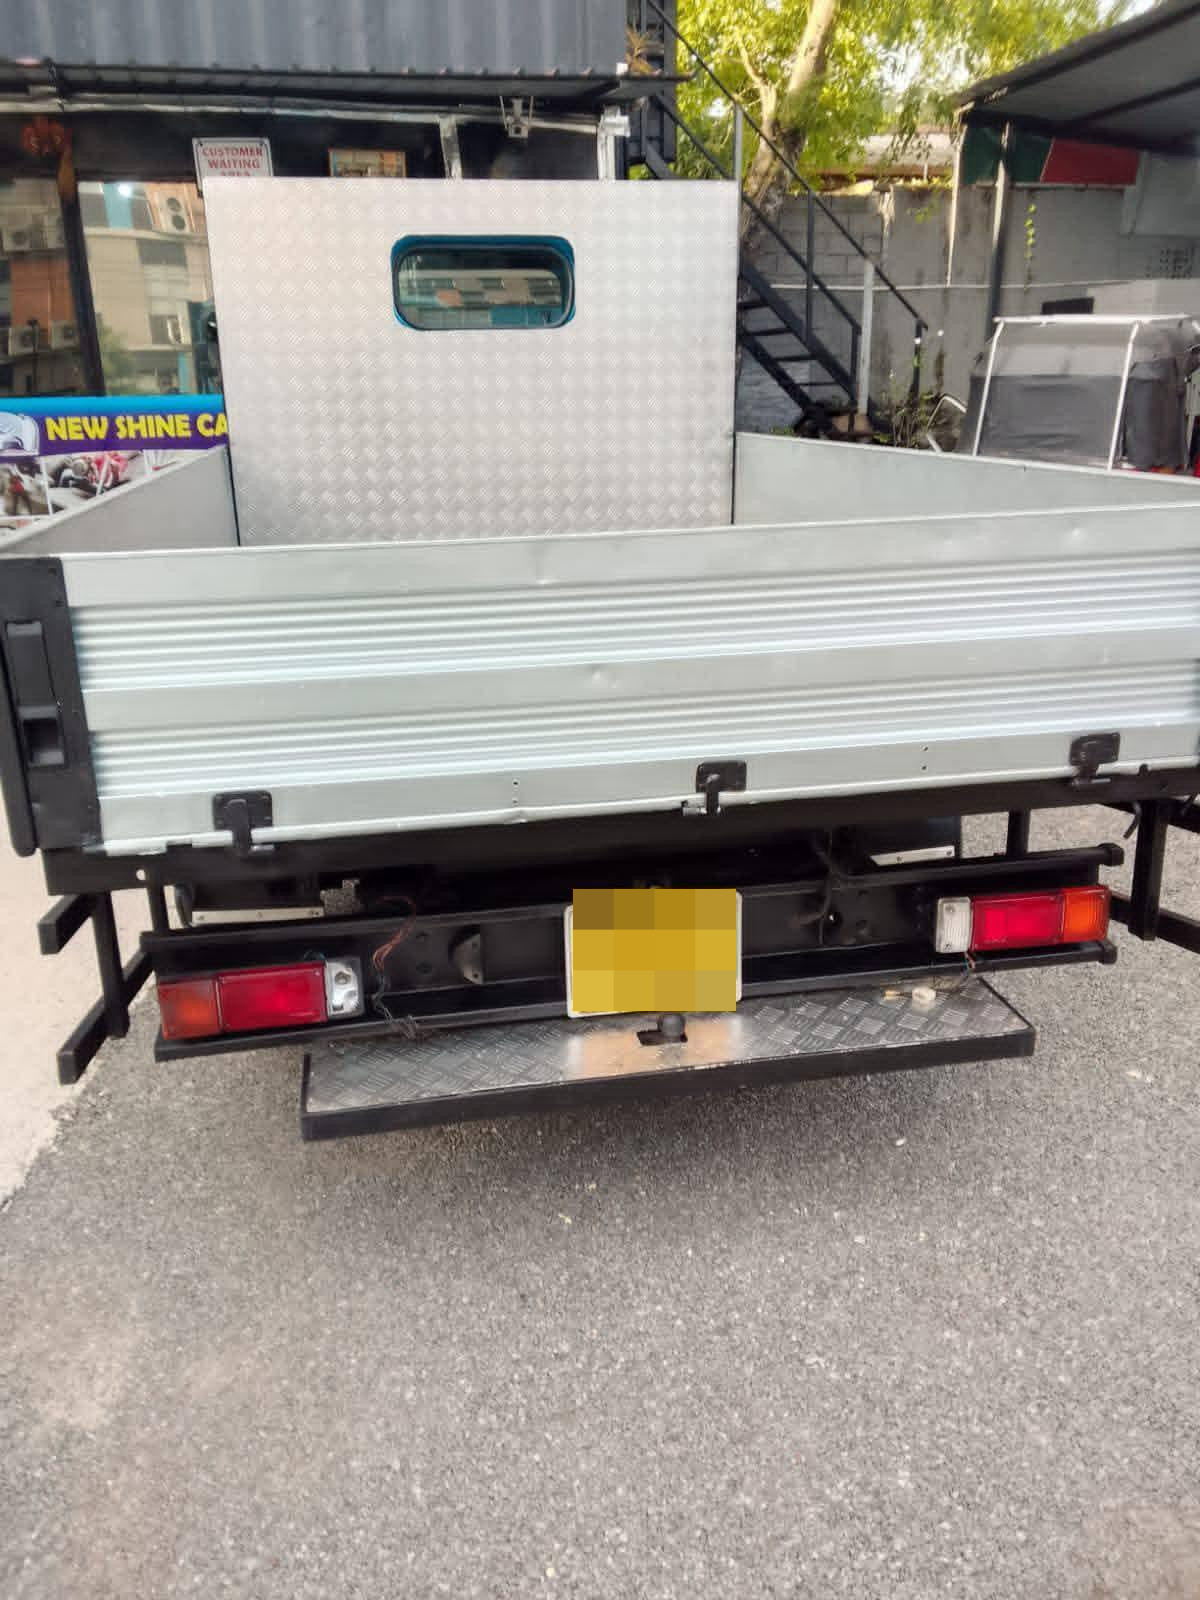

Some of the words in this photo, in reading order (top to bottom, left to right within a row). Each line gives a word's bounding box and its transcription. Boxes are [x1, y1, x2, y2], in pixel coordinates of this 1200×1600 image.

[202, 147, 262, 156] CUSTOMER
[208, 159, 260, 169] WAITING
[45, 416, 108, 440] NEW
[115, 414, 192, 438] SHINE
[196, 413, 228, 437] CA
